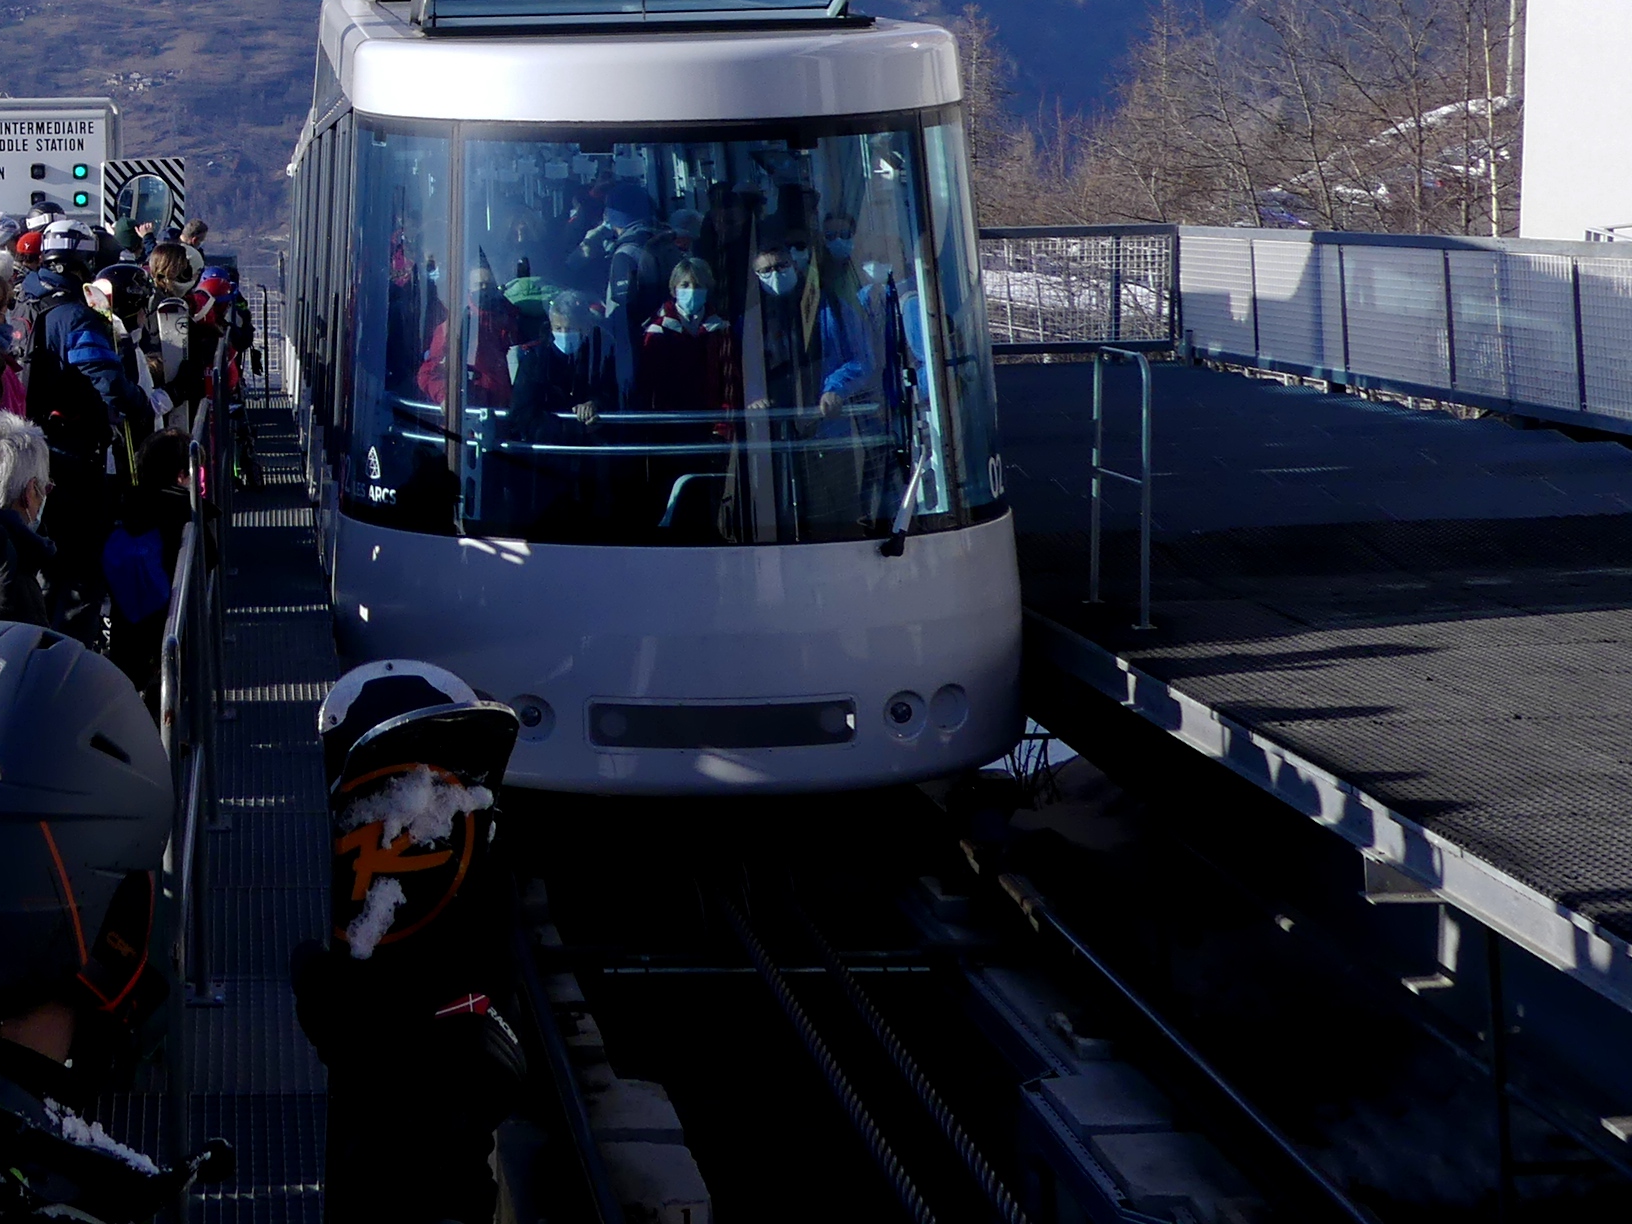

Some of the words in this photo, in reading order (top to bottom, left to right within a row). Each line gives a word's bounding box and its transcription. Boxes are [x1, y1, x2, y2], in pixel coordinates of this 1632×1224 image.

[0, 121, 95, 135] INTERMEDIAIRE
[36, 138, 85, 151] STATION
[988, 453, 1005, 499] 02
[368, 484, 397, 505] ARCS
